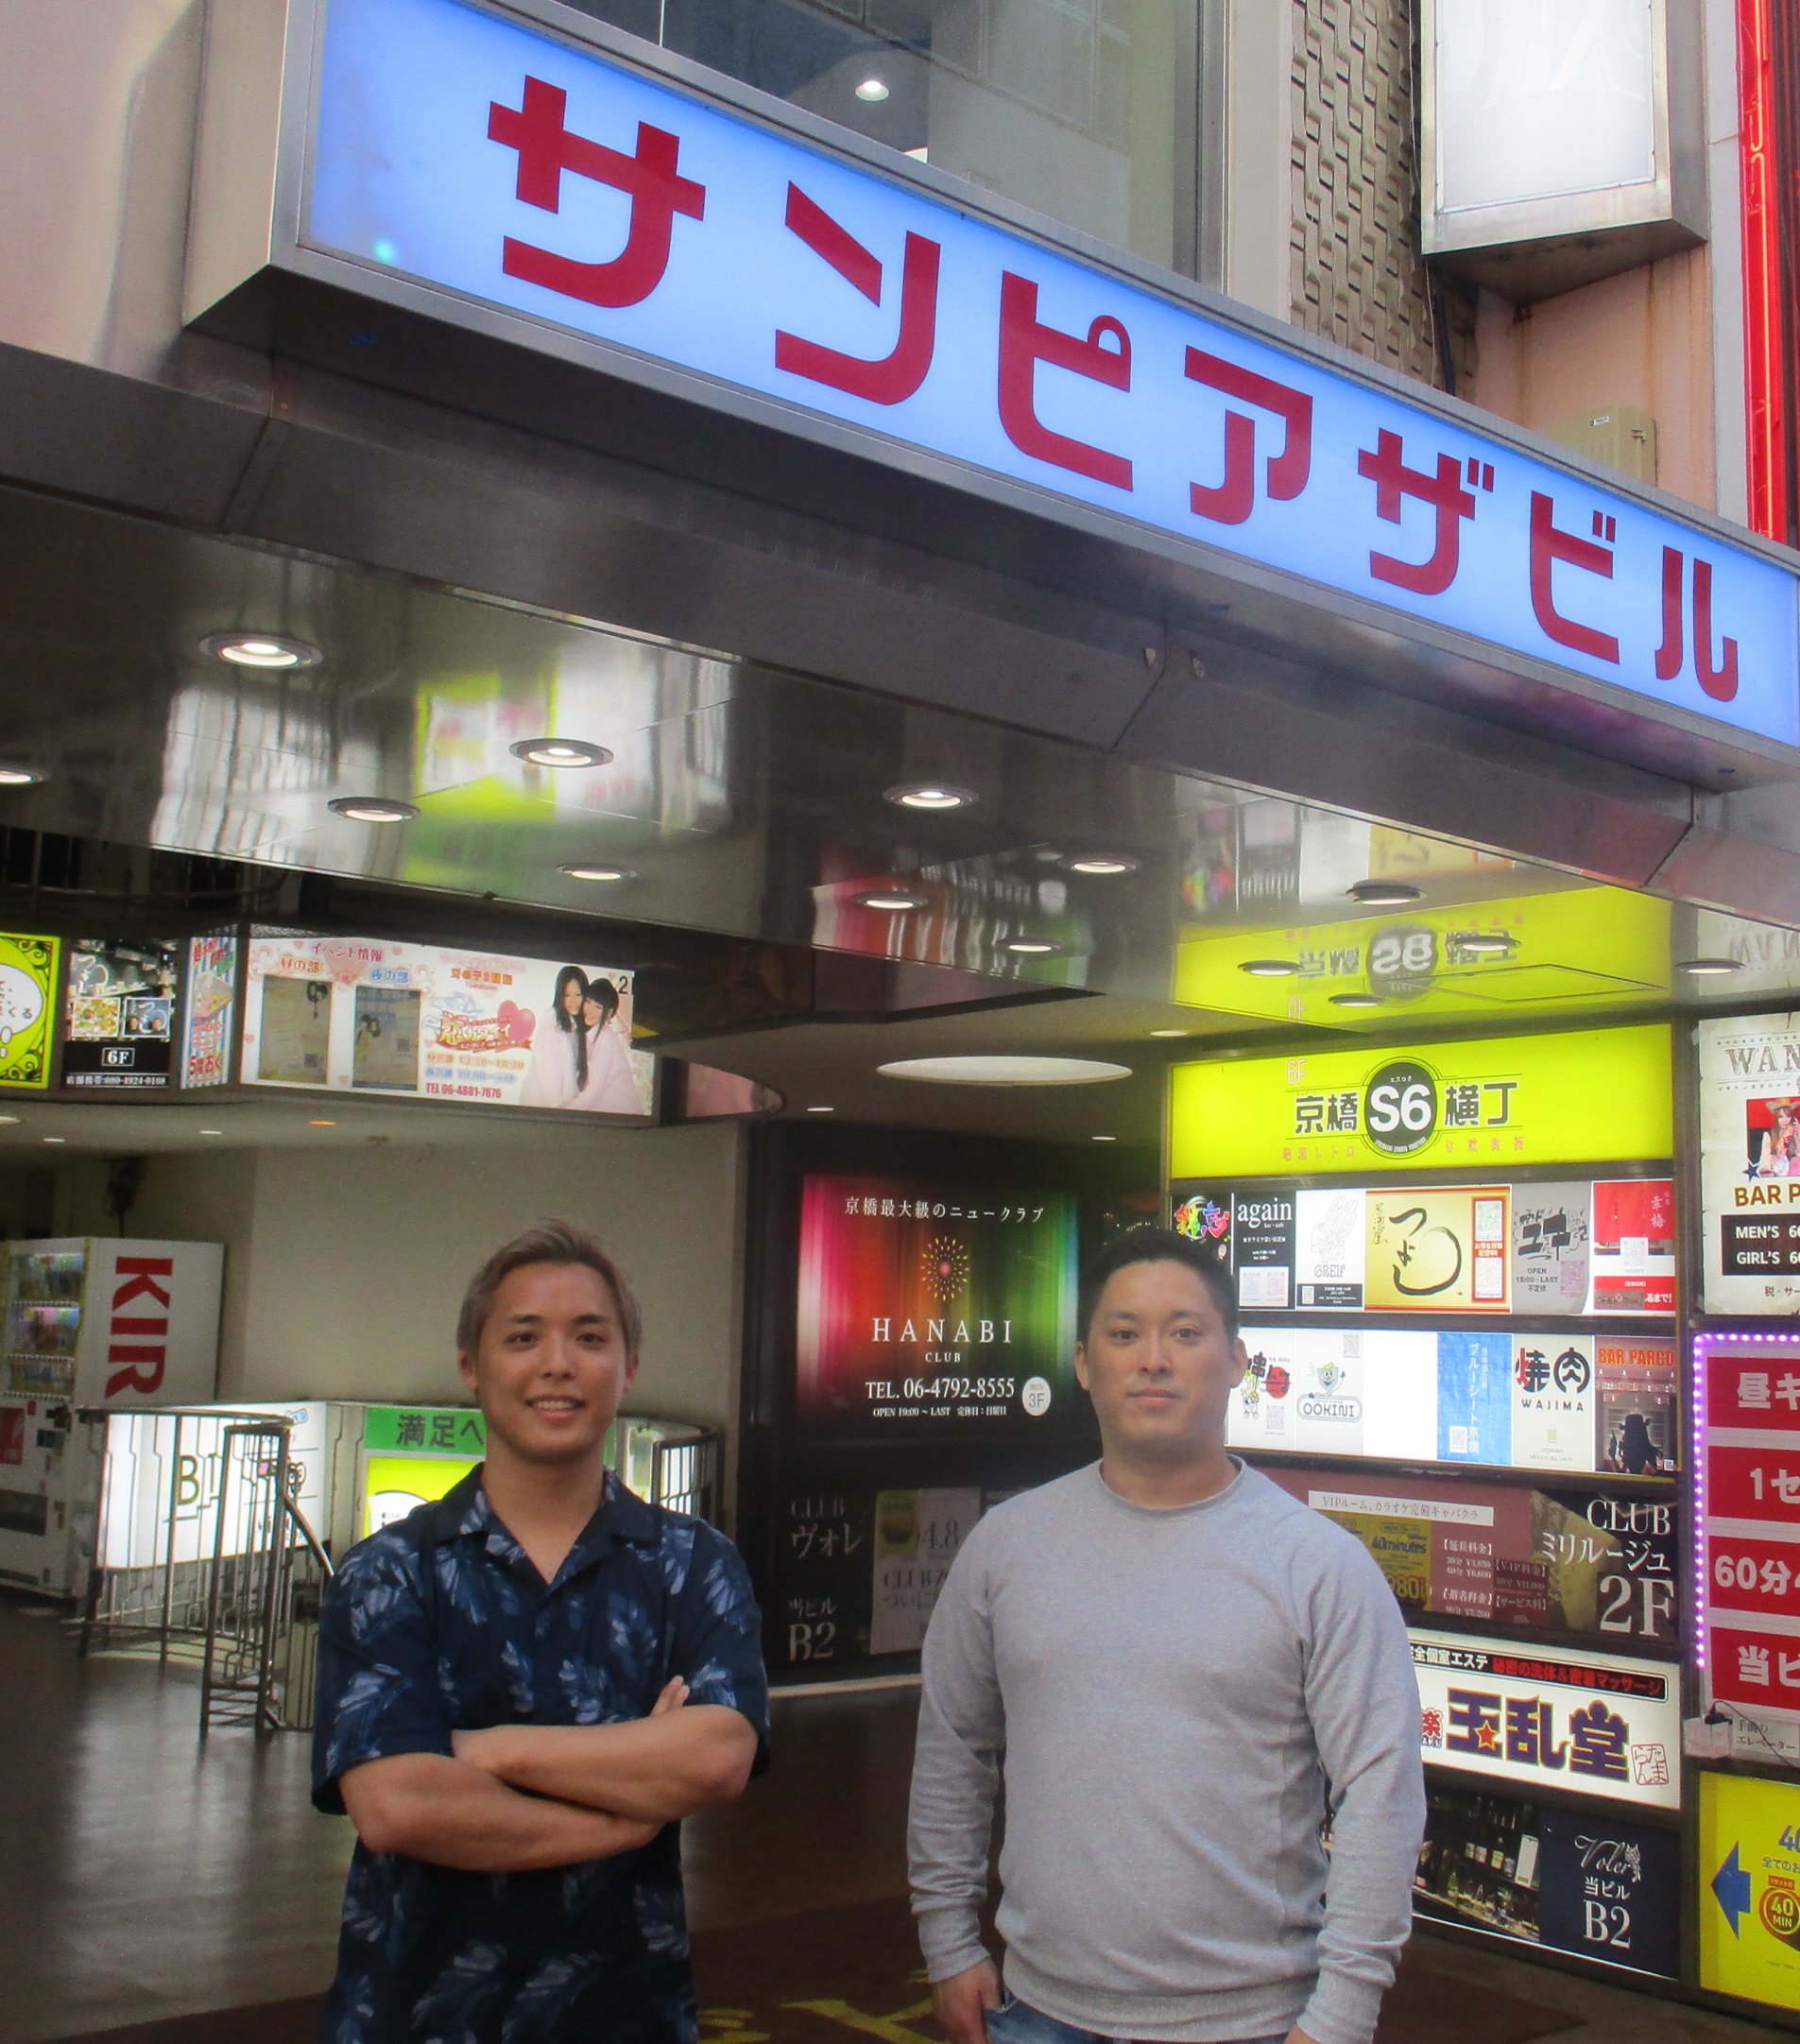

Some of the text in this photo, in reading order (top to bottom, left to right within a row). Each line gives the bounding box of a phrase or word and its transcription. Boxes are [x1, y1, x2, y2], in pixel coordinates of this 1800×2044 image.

[488, 75, 1739, 702] サンピアザビル
[312, 943, 384, 963] イベント情報
[107, 1049, 129, 1065] 6F
[1287, 1058, 1308, 1086] 6F
[426, 1082, 440, 1094] TEL
[1294, 1081, 1518, 1135] 京橋 S6 横丁
[1735, 1184, 1783, 1207] BAR
[844, 1195, 1045, 1224] 京橋最大級のニュークラブ
[1237, 1196, 1293, 1229] again
[1736, 1225, 1780, 1239] MEN'S
[1736, 1250, 1781, 1265] GIRL'S
[871, 1316, 1013, 1345] HANABI
[924, 1350, 963, 1364] CLUB
[1599, 1348, 1676, 1366] BAR PARCO
[1515, 1348, 1590, 1394] 焼肉
[865, 1376, 1016, 1400] TEL. 06-4792-8555
[1467, 1342, 1480, 1454] ブルーシート京橋
[872, 1406, 897, 1417] OPEN
[931, 1406, 951, 1417] LAST
[1027, 1393, 1046, 1409] 3F
[1303, 1402, 1355, 1417] OOKINI
[1521, 1398, 1585, 1412] WAJIMA
[1586, 1499, 1671, 1536] CLUB
[1540, 1531, 1672, 1572] ミリルージュ
[1714, 1554, 1800, 1596] 60分
[1599, 1575, 1674, 1637] 2F
[789, 1621, 837, 1662] B2
[1584, 1876, 1631, 1900] 当ビル
[1770, 1896, 1793, 1916] 40
[1584, 1898, 1631, 1950] B2
[1773, 1914, 1792, 1928] MIN
